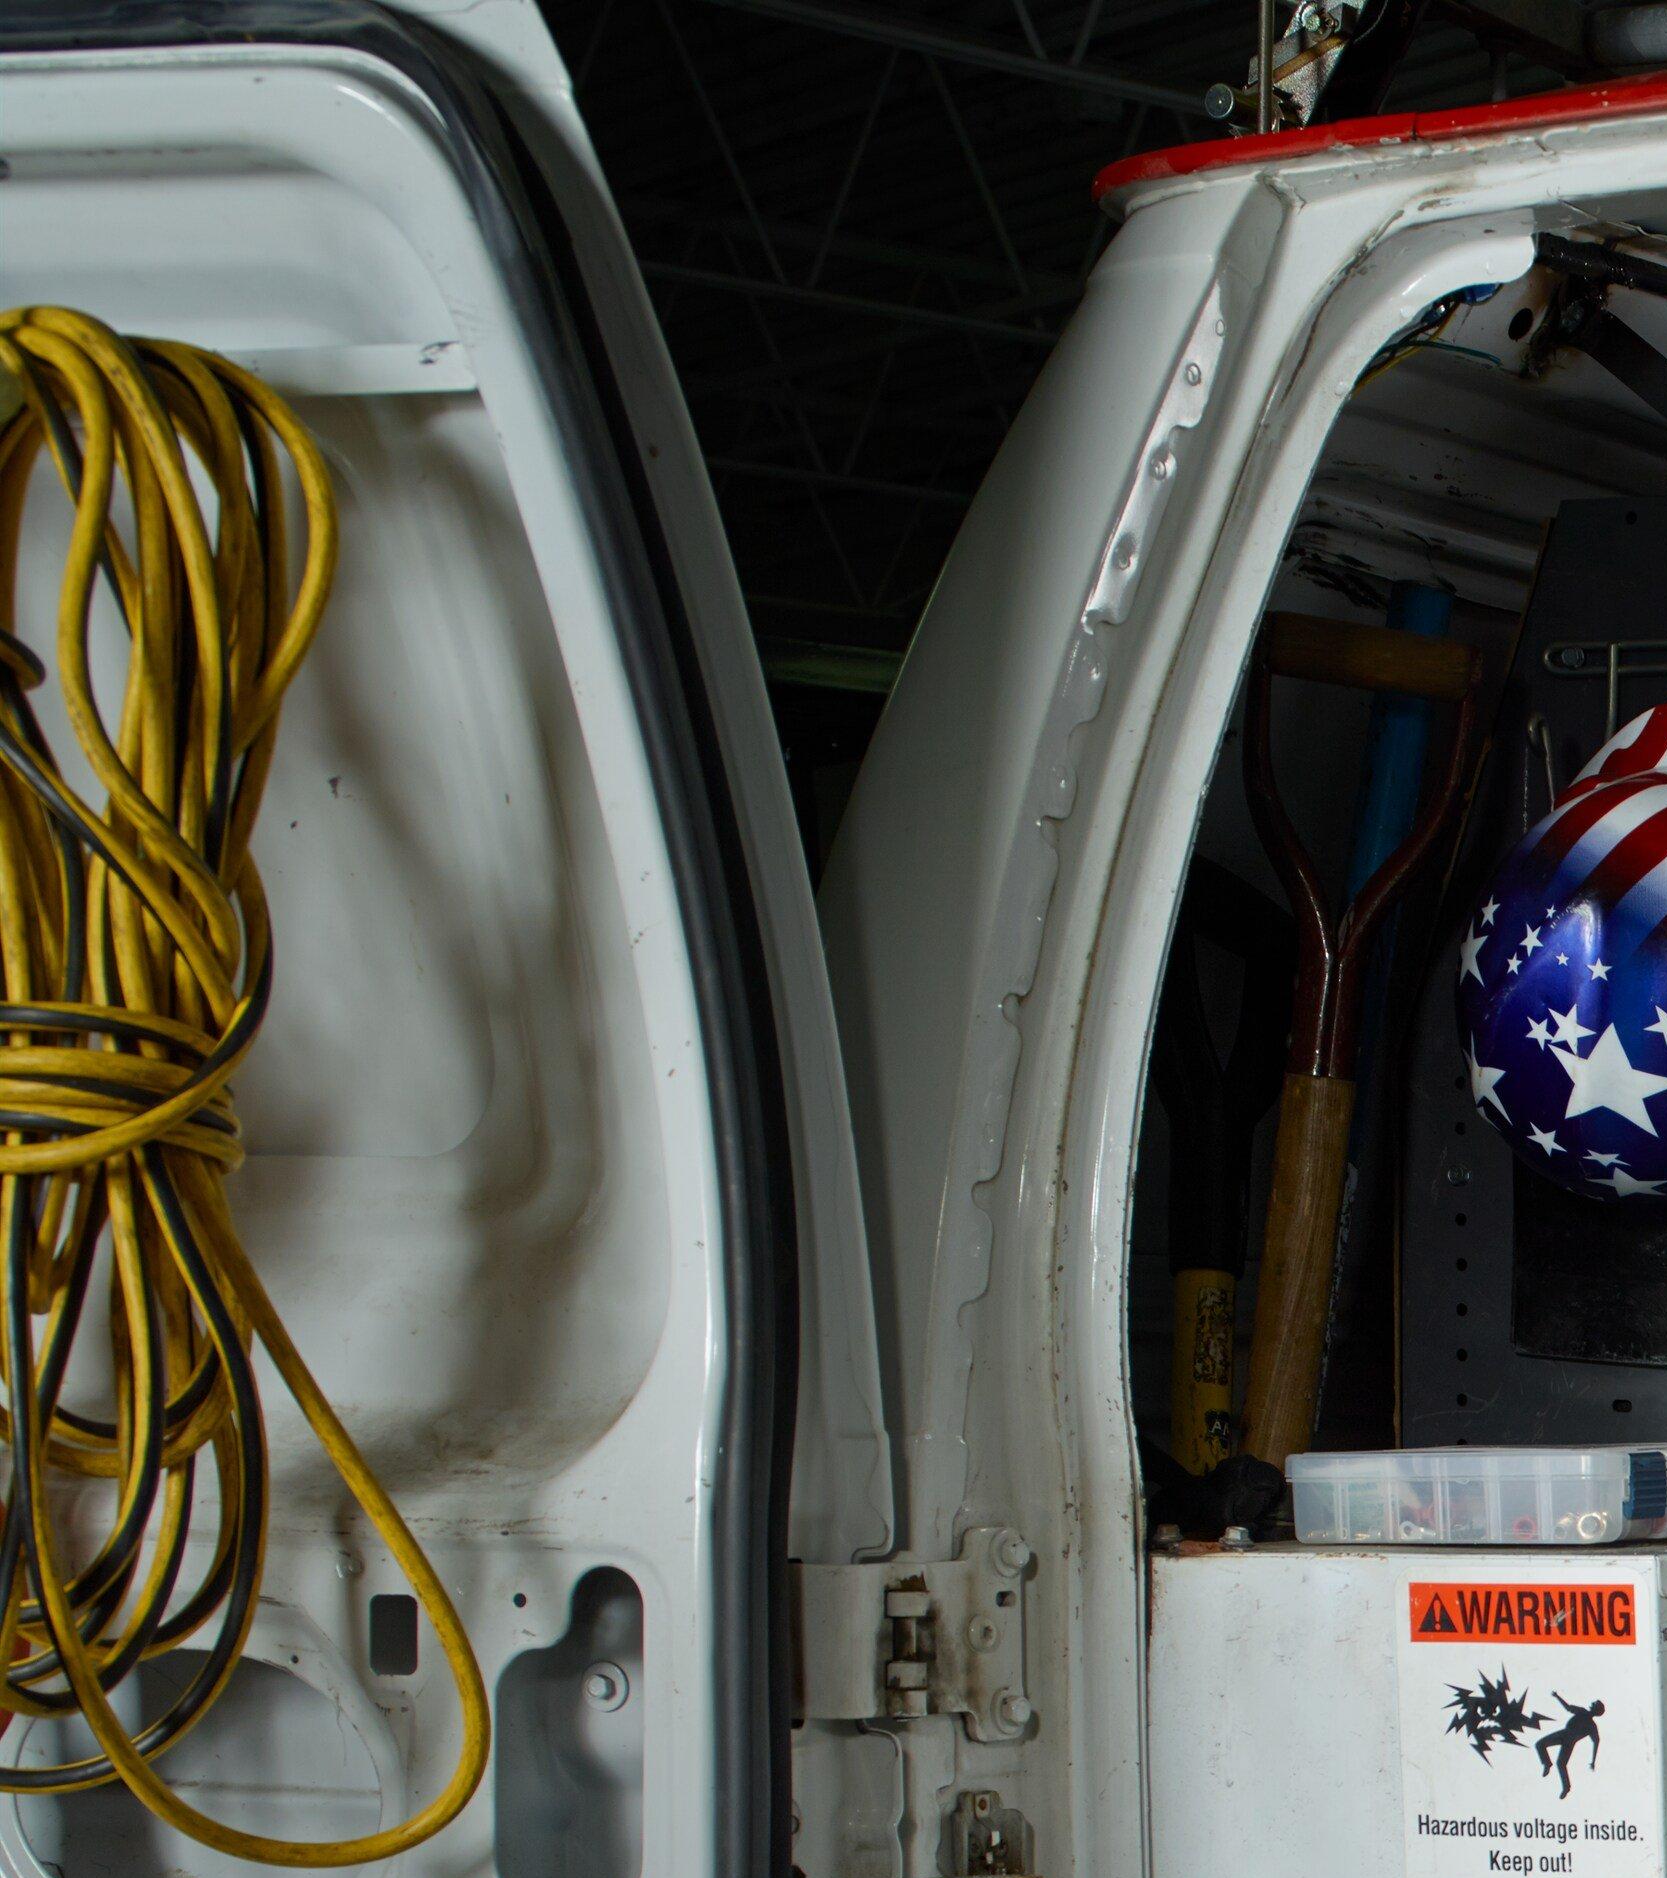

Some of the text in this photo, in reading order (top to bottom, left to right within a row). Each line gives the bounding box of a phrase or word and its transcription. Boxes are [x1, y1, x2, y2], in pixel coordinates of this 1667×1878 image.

[1457, 1590, 1633, 1637] WARNING
[1417, 1814, 1645, 1843] Hazardous voltage inside.
[1489, 1850, 1573, 1876] Keep out!
